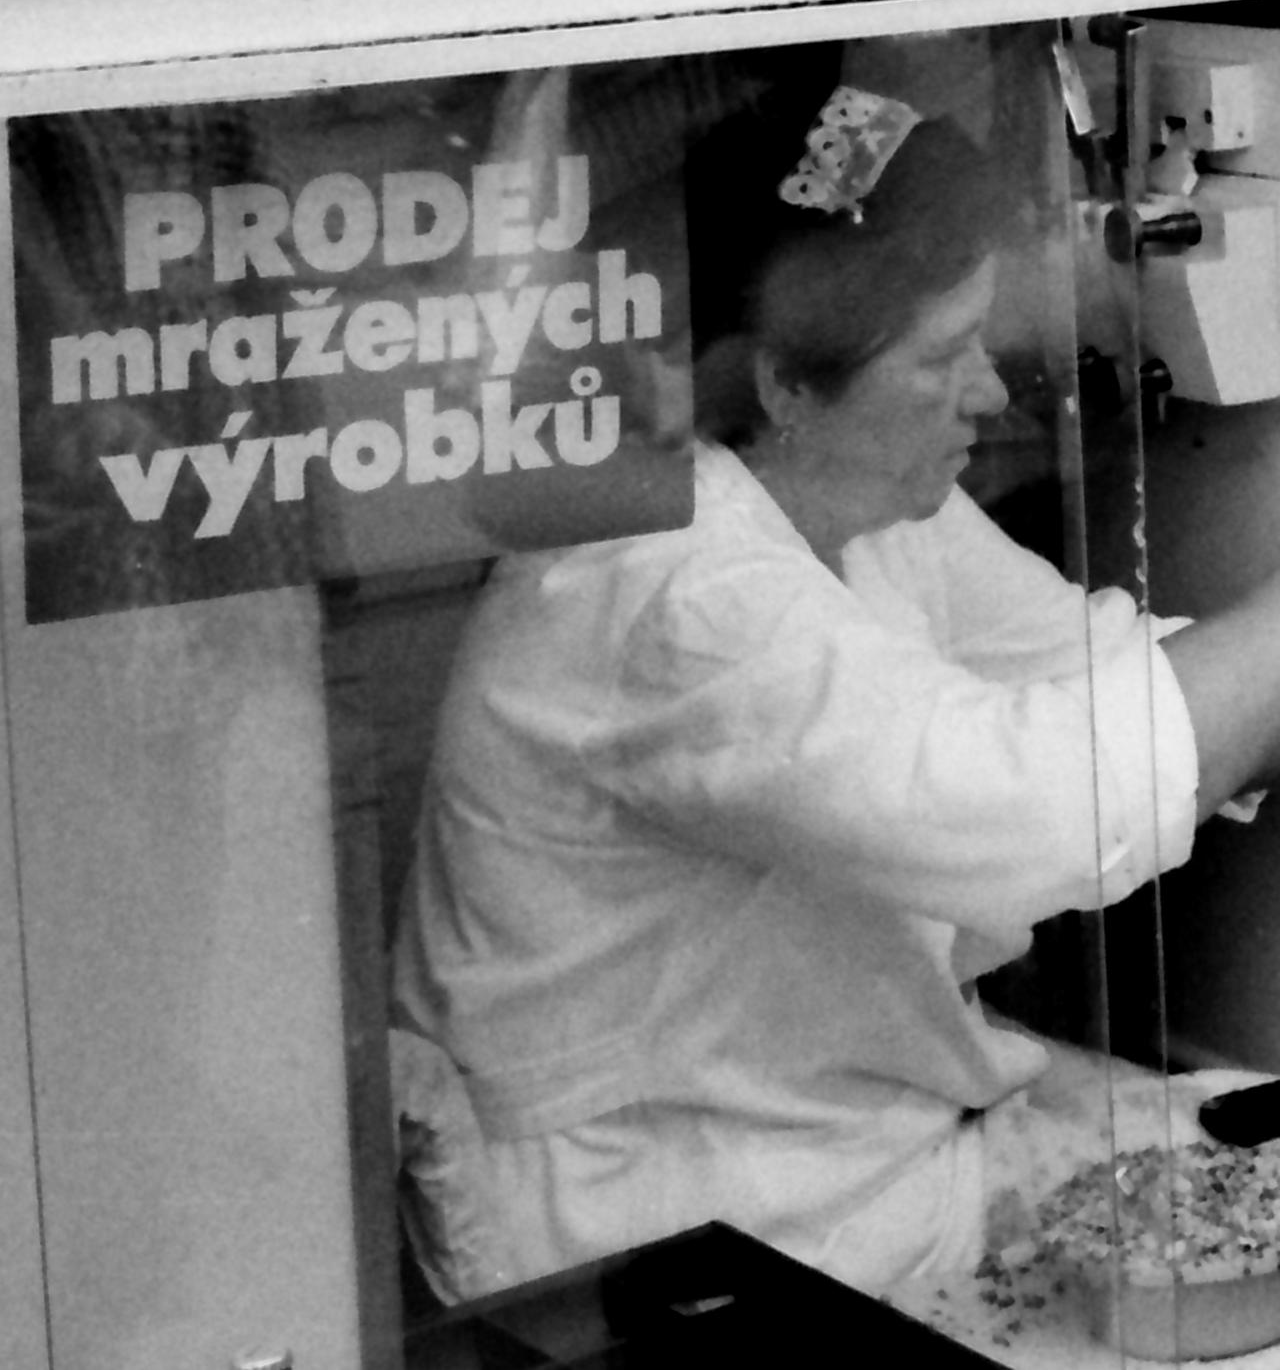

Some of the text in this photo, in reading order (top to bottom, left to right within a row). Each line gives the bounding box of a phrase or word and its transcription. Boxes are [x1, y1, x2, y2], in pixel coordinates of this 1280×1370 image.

[123, 155, 590, 293] PRODEJ
[50, 249, 662, 405] mražených
[100, 366, 621, 540] výrobků
